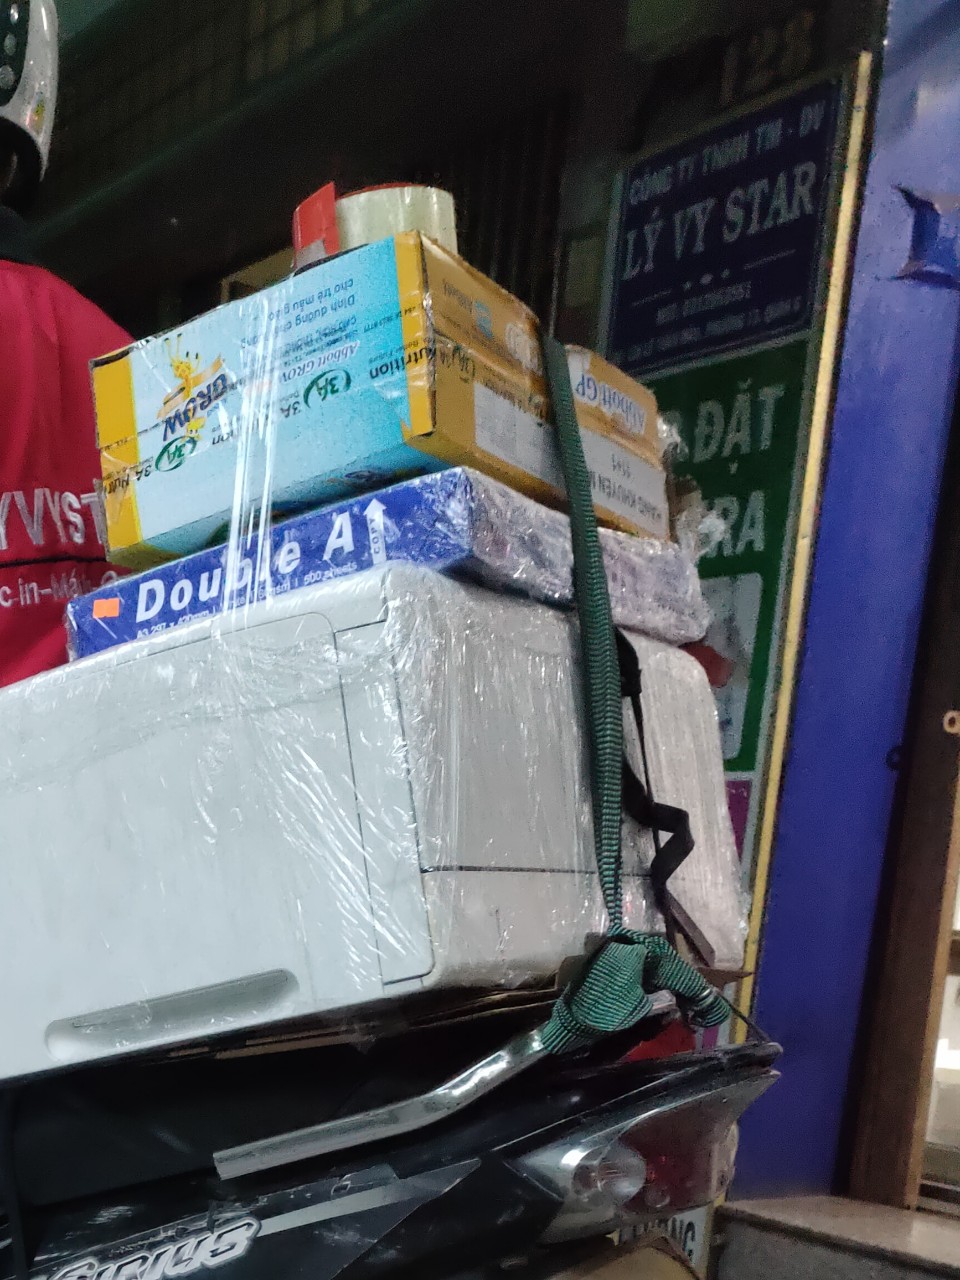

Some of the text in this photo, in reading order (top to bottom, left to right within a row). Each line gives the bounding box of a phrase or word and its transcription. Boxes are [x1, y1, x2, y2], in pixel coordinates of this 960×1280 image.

[623, 161, 818, 279] LÝ VY STAR
[319, 342, 360, 366] Abbott
[163, 374, 228, 442] GROW
[693, 378, 785, 474] ĐẶT
[135, 540, 302, 623] Double
[323, 510, 355, 561] A
